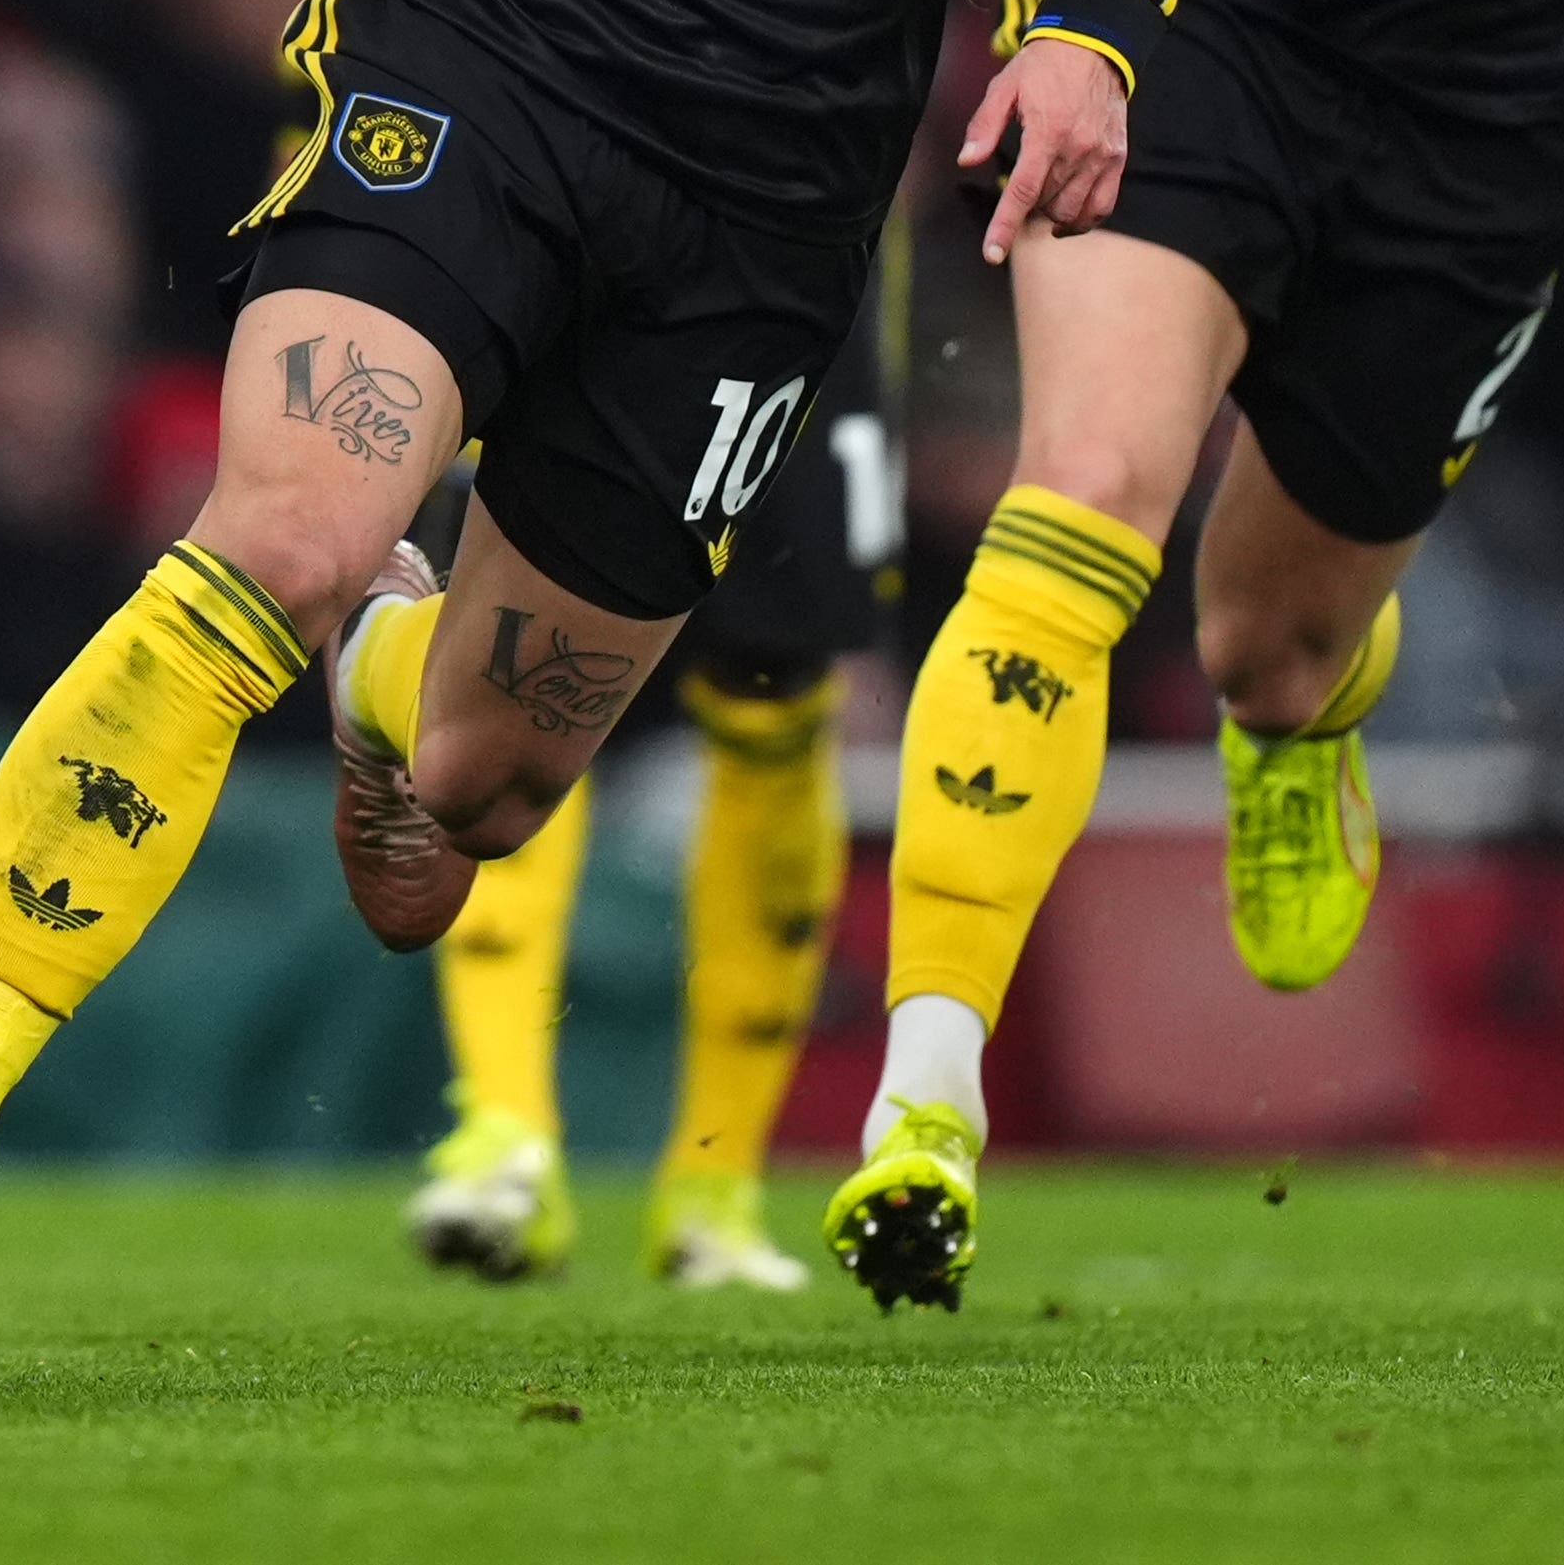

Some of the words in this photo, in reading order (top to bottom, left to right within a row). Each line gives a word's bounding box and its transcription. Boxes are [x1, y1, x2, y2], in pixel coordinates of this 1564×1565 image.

[359, 151, 403, 174] UNITED
[361, 115, 422, 147] MANCHESTER
[683, 374, 806, 522] 10
[830, 411, 908, 570] 1
